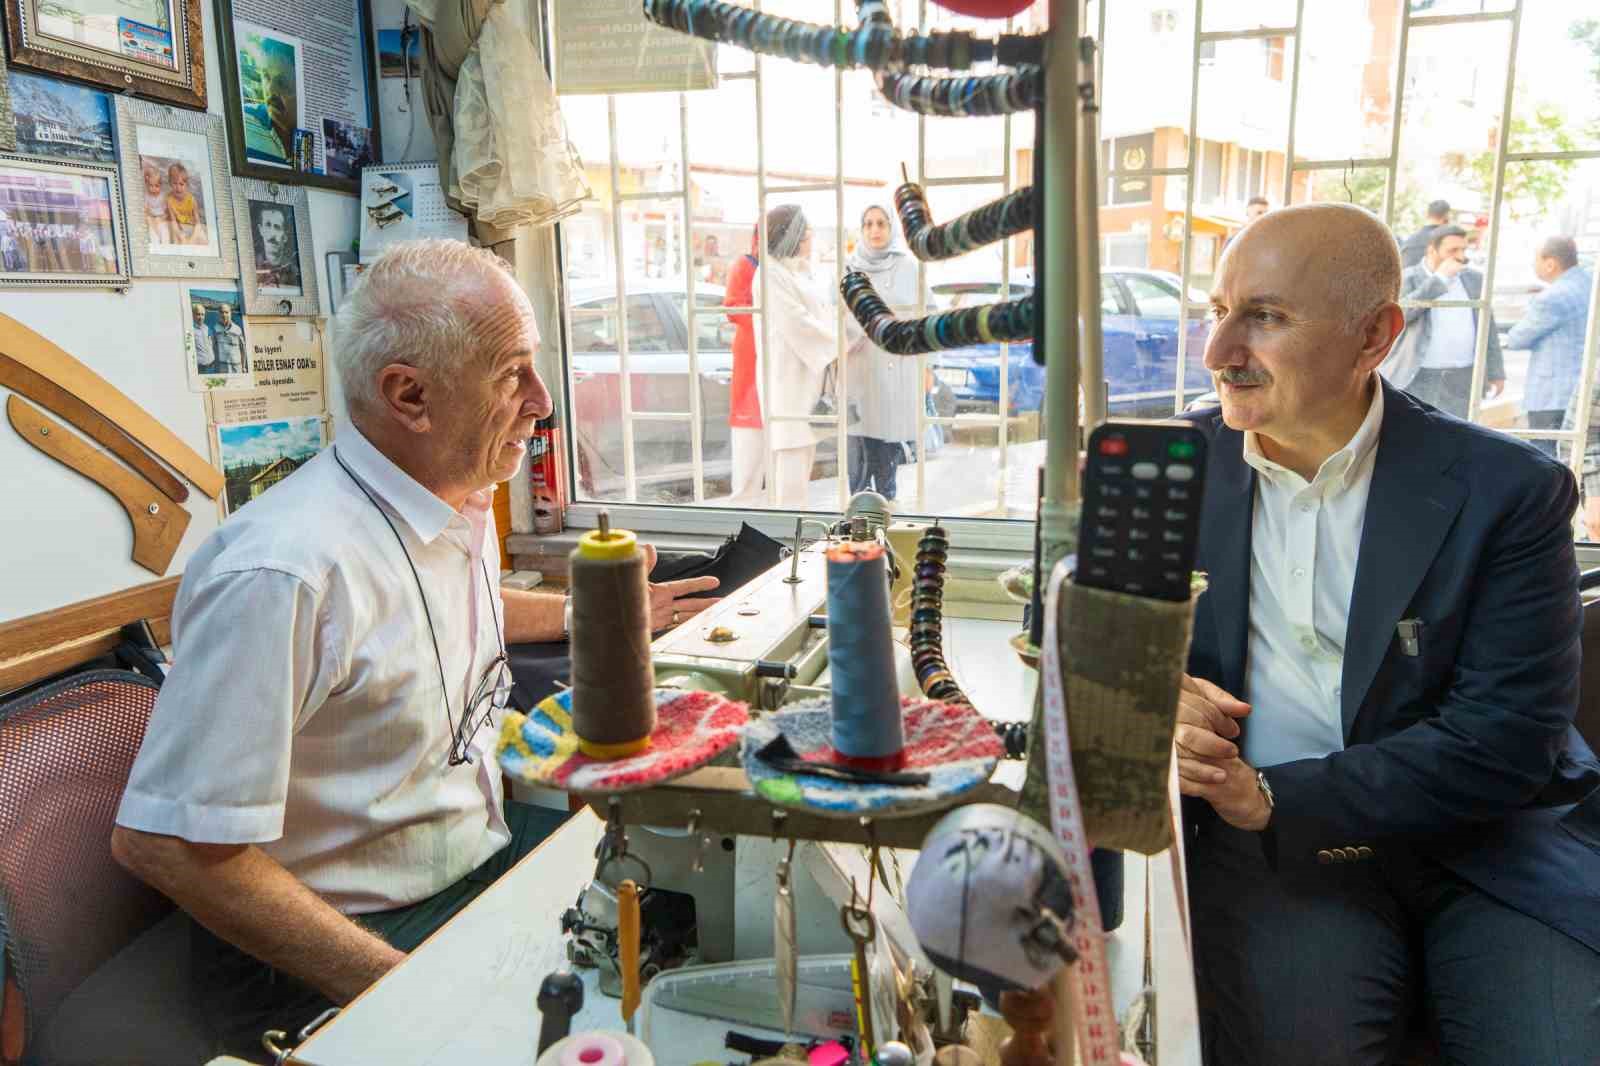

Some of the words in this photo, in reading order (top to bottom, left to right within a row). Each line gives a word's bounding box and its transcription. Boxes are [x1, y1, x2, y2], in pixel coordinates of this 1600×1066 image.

[254, 345, 263, 353] Bu
[253, 359, 275, 370] RZİLER
[275, 358, 295, 370] ESNAF
